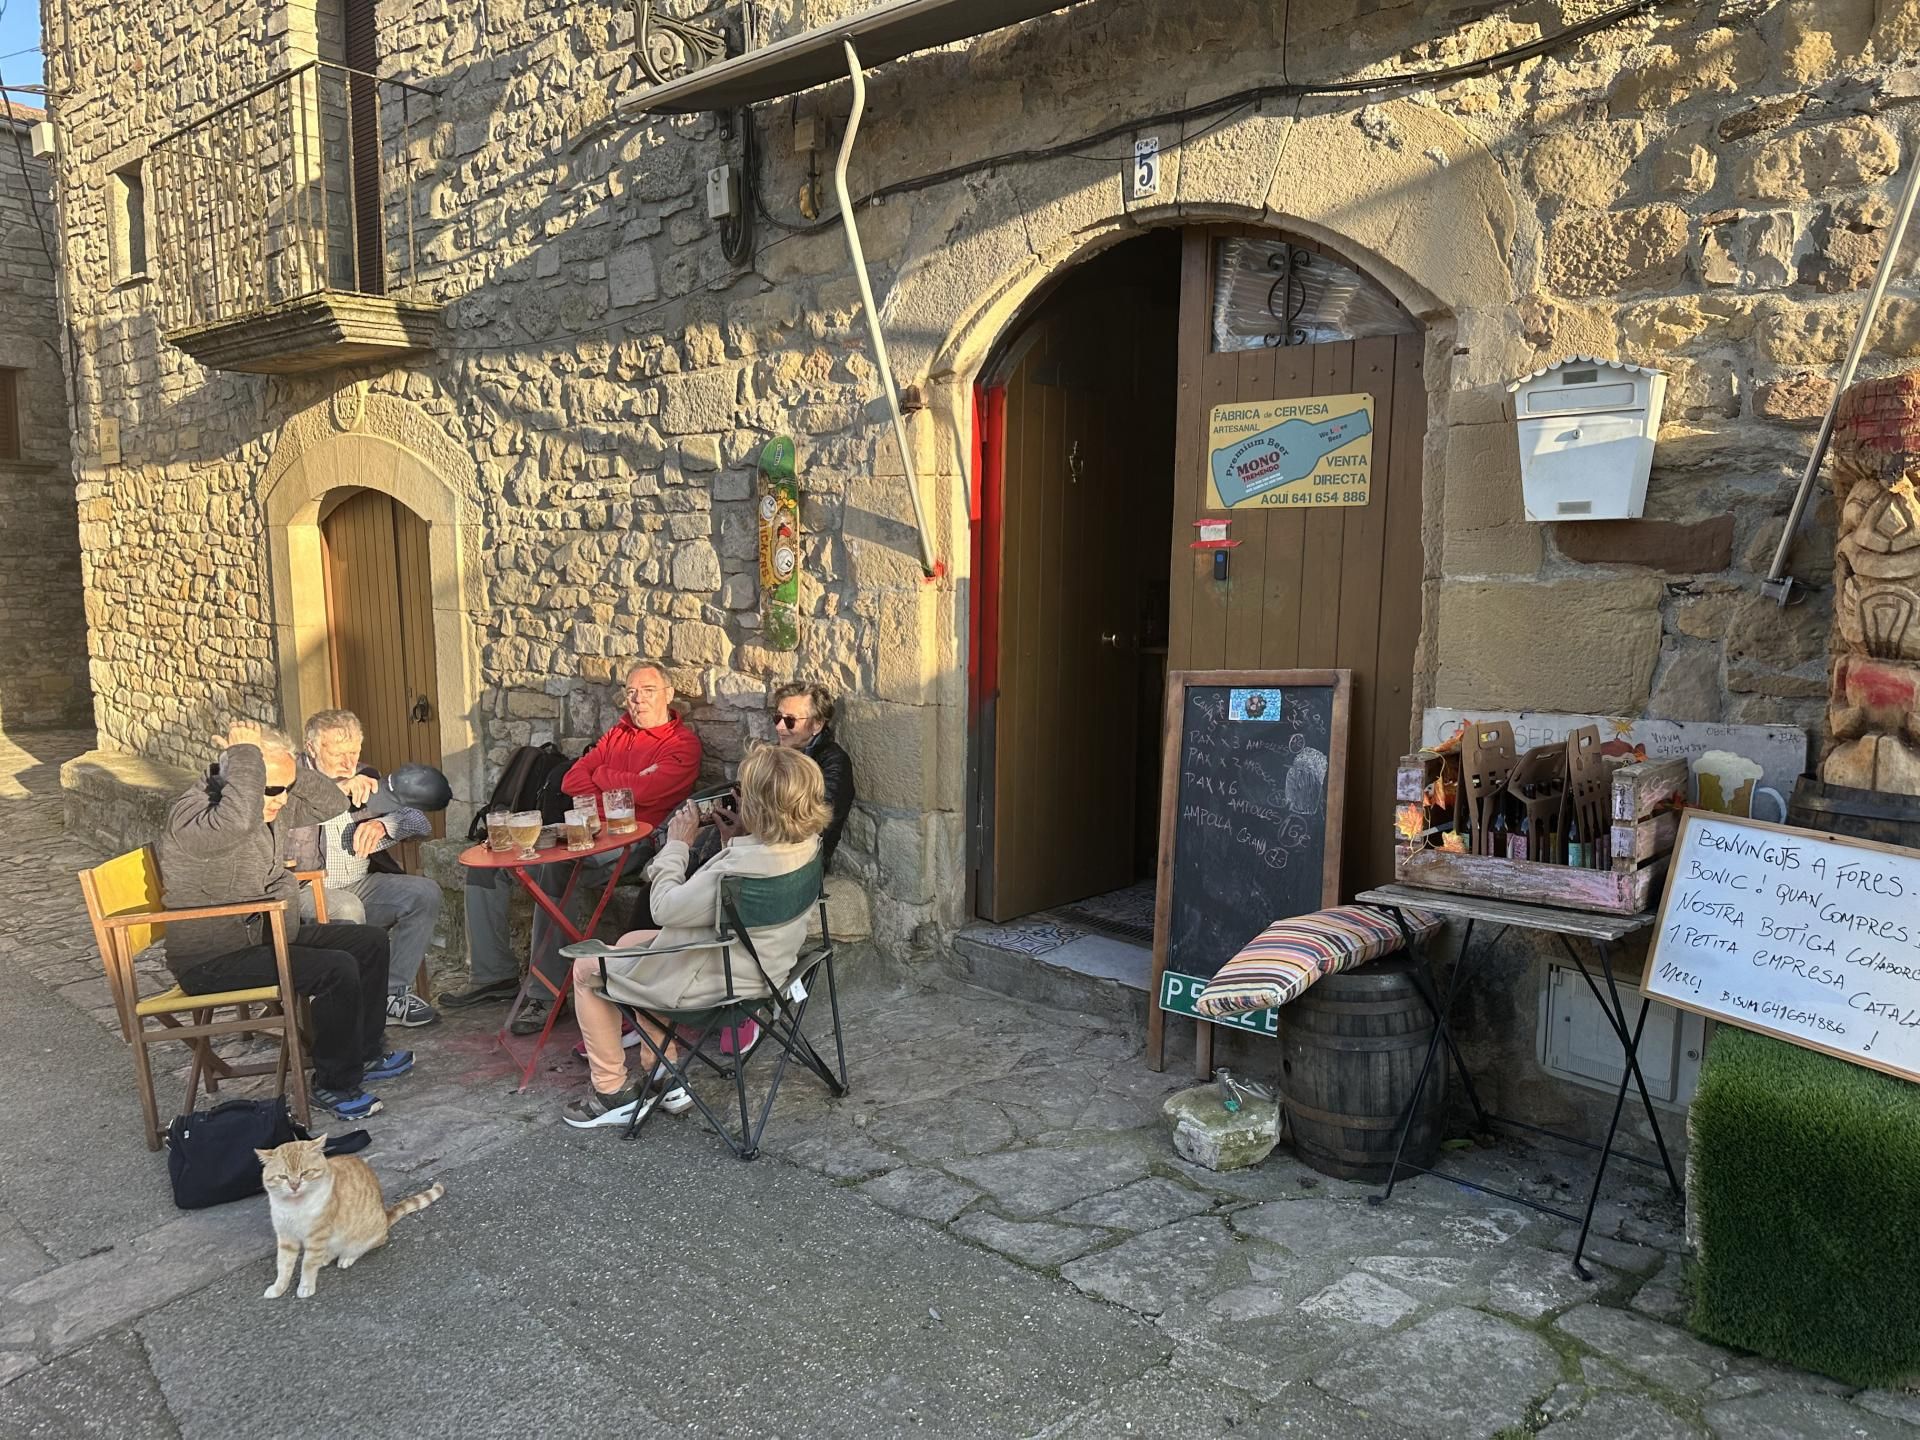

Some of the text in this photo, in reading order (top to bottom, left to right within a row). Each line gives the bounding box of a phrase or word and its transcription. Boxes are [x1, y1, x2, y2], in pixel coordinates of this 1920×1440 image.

[1139, 151, 1154, 187] 5
[1274, 404, 1329, 418] CERVESA
[1213, 424, 1260, 434] ARTESANAL
[1226, 438, 1289, 477] Premium Beer
[1236, 451, 1280, 477] MONO
[1326, 455, 1368, 467] VENTA
[1242, 464, 1279, 482] TREMENDO
[1313, 473, 1367, 486] DIRECTA
[1292, 493, 1312, 504] 641
[1315, 492, 1338, 503] 654
[1343, 491, 1366, 503] 886
[1811, 857, 1826, 880] A
[1776, 884, 1822, 908] QUAN
[1676, 892, 1744, 928] NOSTRA
[1762, 1001, 1846, 1034] 641654886
